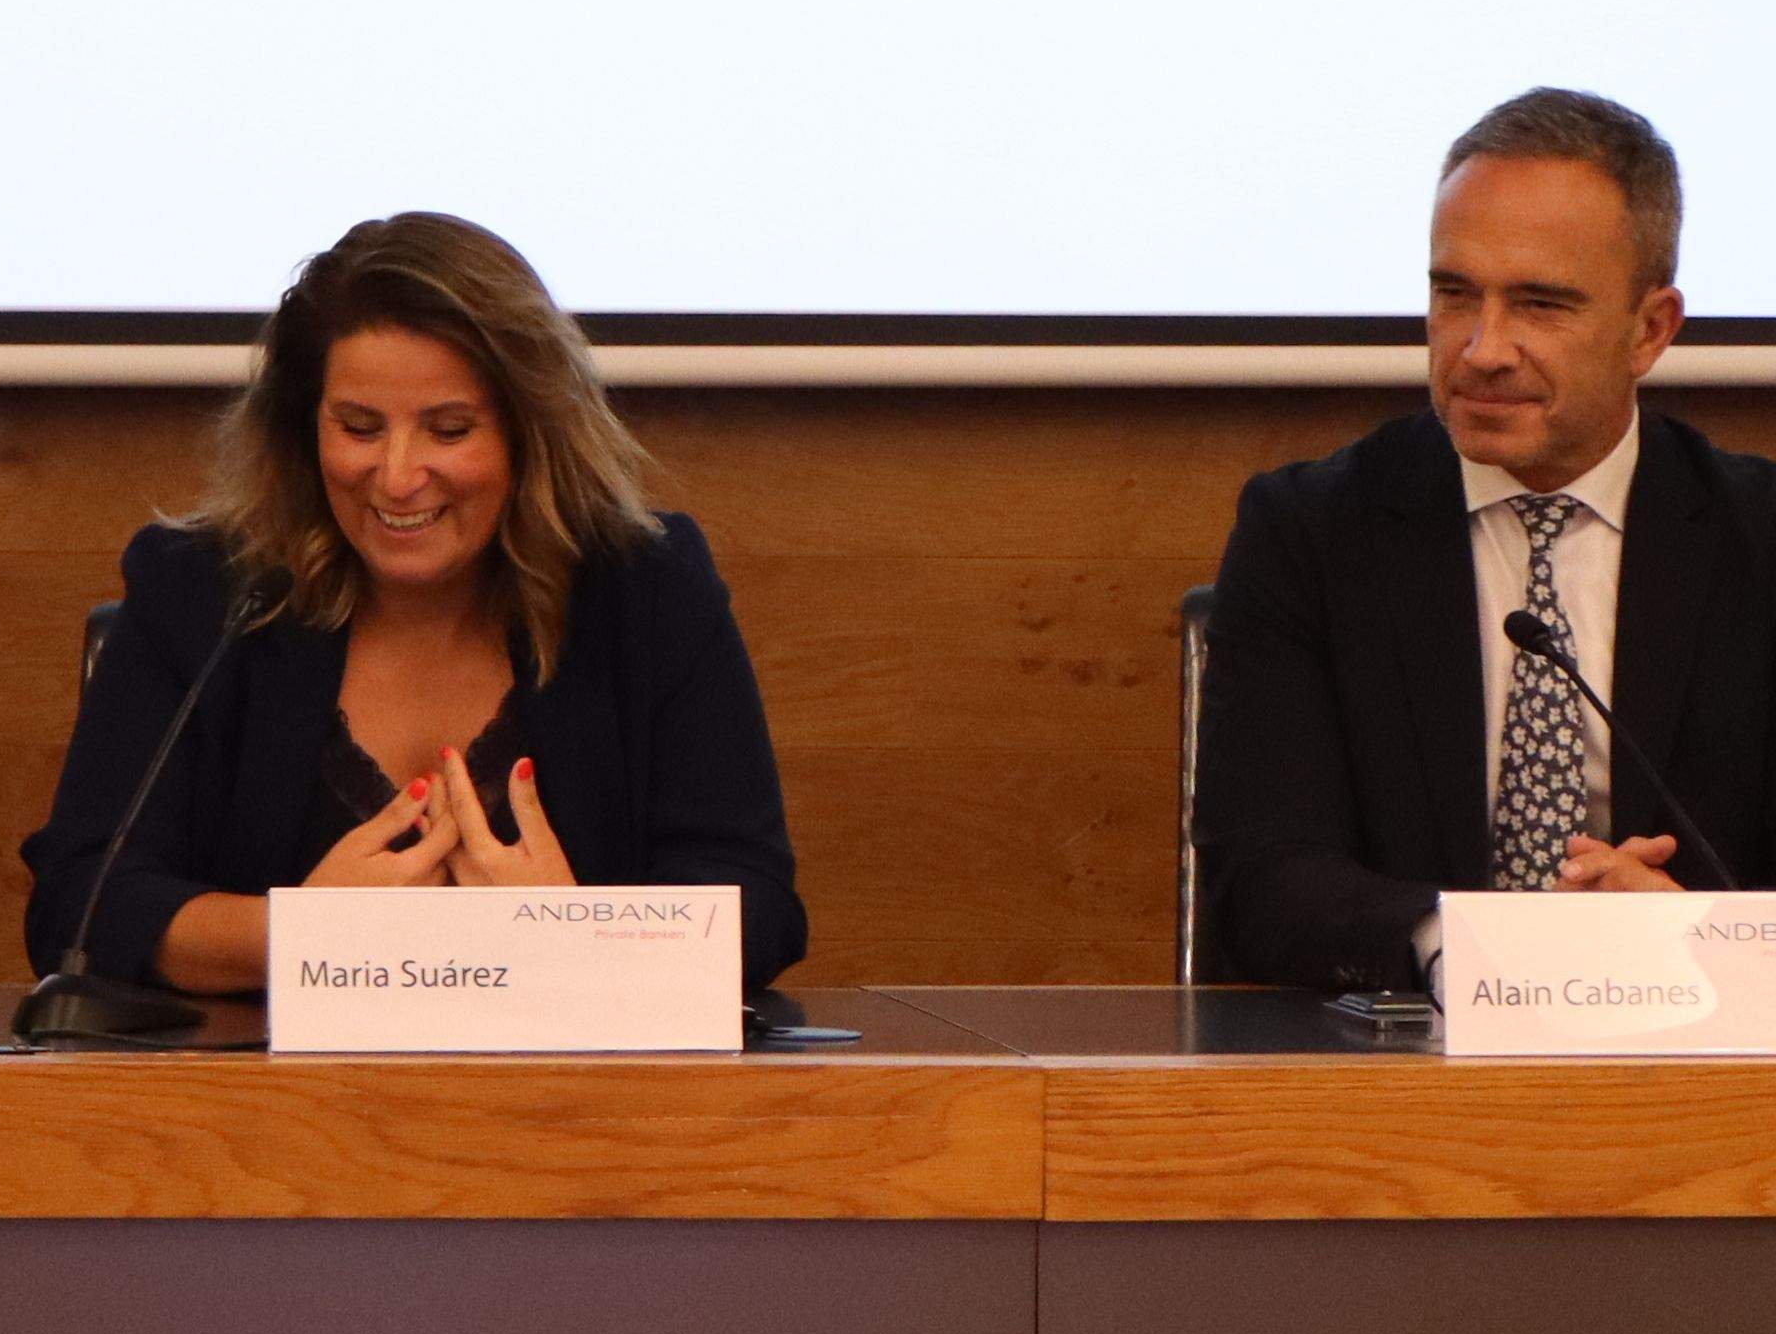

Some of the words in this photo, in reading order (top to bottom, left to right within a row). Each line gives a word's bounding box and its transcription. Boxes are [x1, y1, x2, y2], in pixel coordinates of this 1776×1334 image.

[512, 902, 693, 922] ANDBANK
[299, 960, 390, 988] Maria
[400, 958, 509, 988] Suárez
[1472, 977, 1553, 1006] Alain
[1562, 977, 1701, 1006] Cabanes
